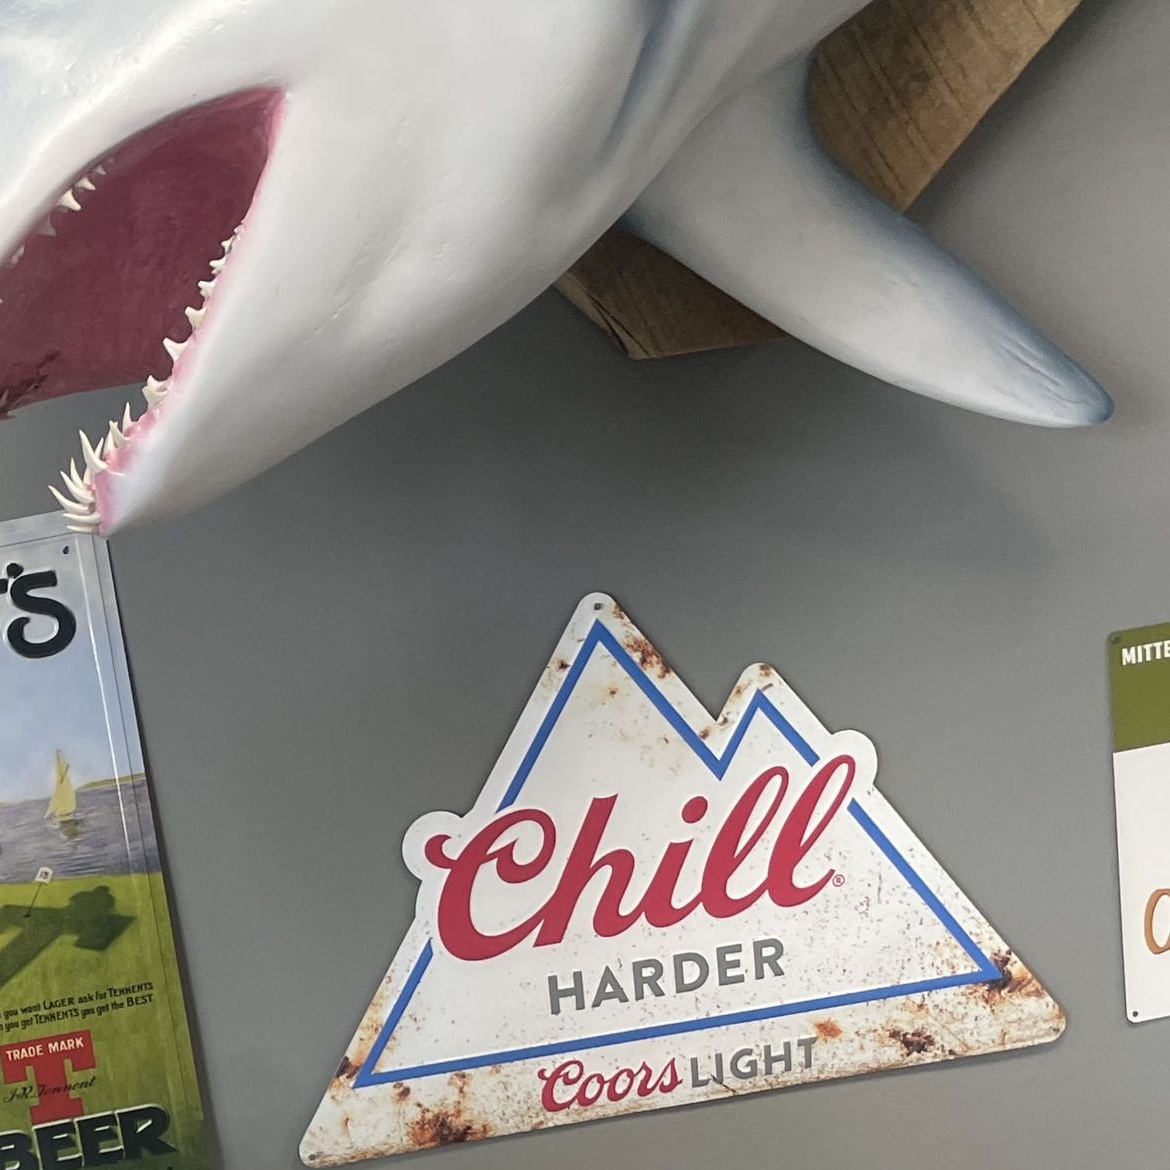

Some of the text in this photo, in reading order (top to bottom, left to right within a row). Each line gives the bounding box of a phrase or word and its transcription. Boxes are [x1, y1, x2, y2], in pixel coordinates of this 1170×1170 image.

[425, 755, 858, 961] Chill
[548, 938, 785, 1015] HARDER
[3, 1009, 18, 1020] you
[43, 997, 75, 1010] LAGER
[78, 993, 94, 1004] ask
[4, 1021, 20, 1032] you
[81, 1008, 95, 1019] you
[96, 1003, 109, 1016] get
[110, 1001, 124, 1010] the
[126, 994, 154, 1007] BEST
[6, 1037, 84, 1062] TRADE MARK
[538, 1036, 819, 1113] Coors LIGHT
